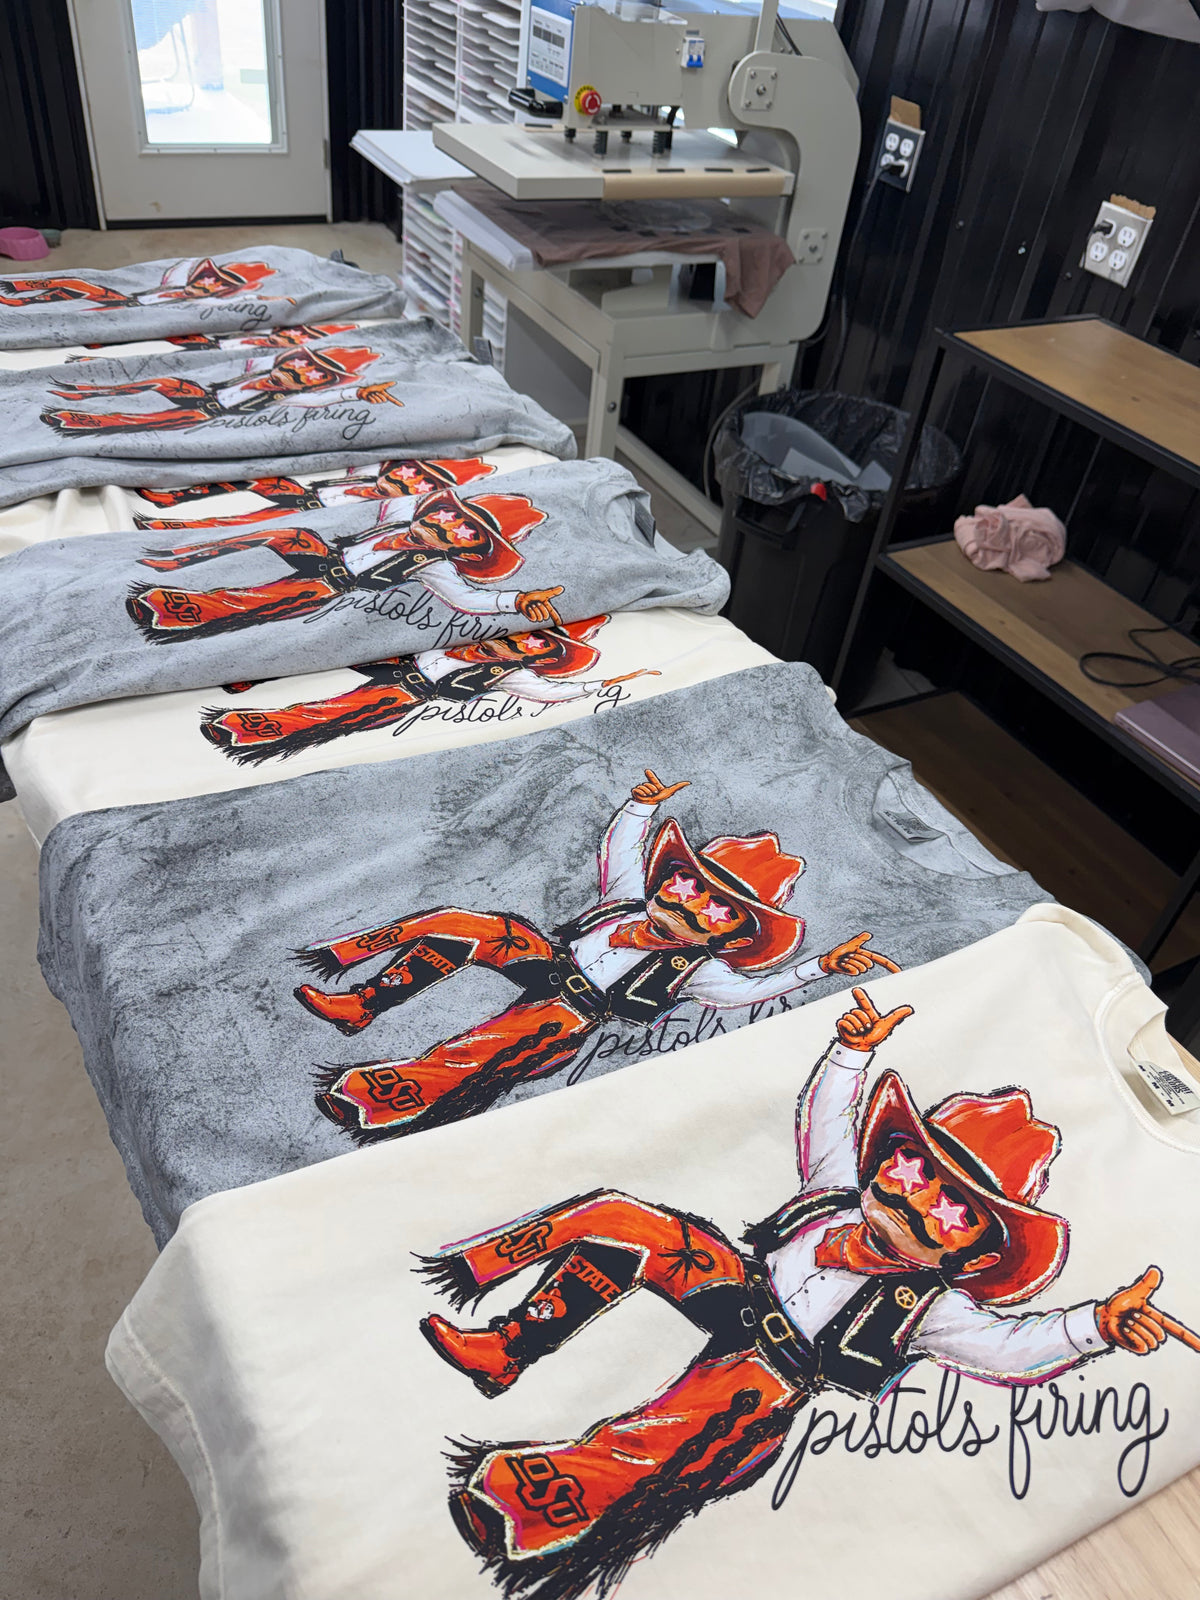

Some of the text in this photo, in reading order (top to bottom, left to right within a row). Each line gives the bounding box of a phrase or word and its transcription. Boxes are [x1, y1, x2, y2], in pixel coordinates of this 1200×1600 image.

[292, 404, 377, 441] firing
[162, 591, 202, 623] OSU
[303, 589, 442, 630] pistols
[236, 712, 283, 738] OSU
[414, 944, 458, 975] STATE
[359, 1066, 426, 1112] OSU
[565, 1254, 622, 1303] STATE
[771, 1368, 1169, 1511] pistols firing
[506, 1453, 591, 1528] OSU
